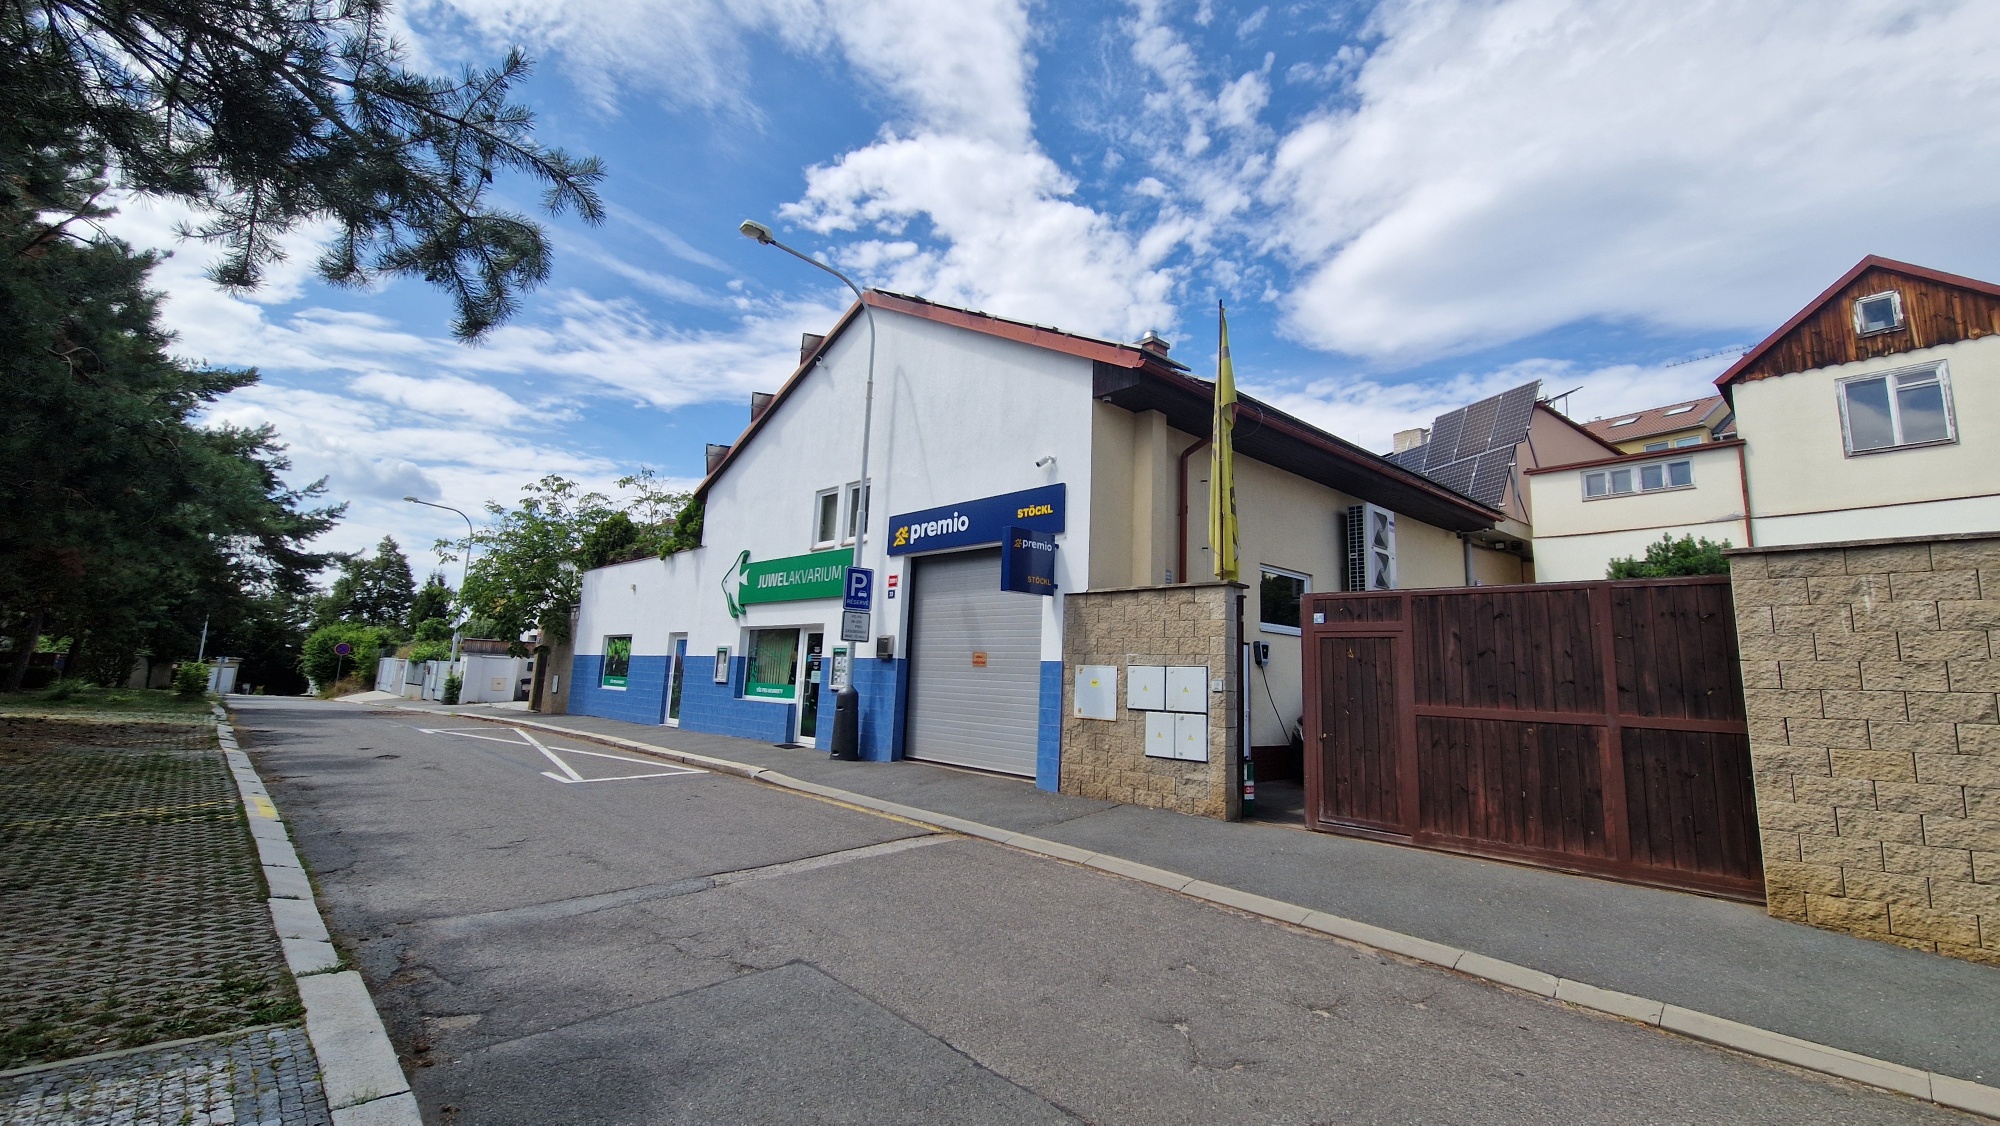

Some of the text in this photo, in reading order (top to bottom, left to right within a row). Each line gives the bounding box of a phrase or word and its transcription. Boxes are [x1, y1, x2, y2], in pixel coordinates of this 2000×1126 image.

[1017, 504, 1054, 518] STÖCKL
[910, 511, 969, 545] premio
[1022, 539, 1053, 552] premio
[851, 573, 867, 596] P
[1027, 576, 1052, 586] STÖCKL
